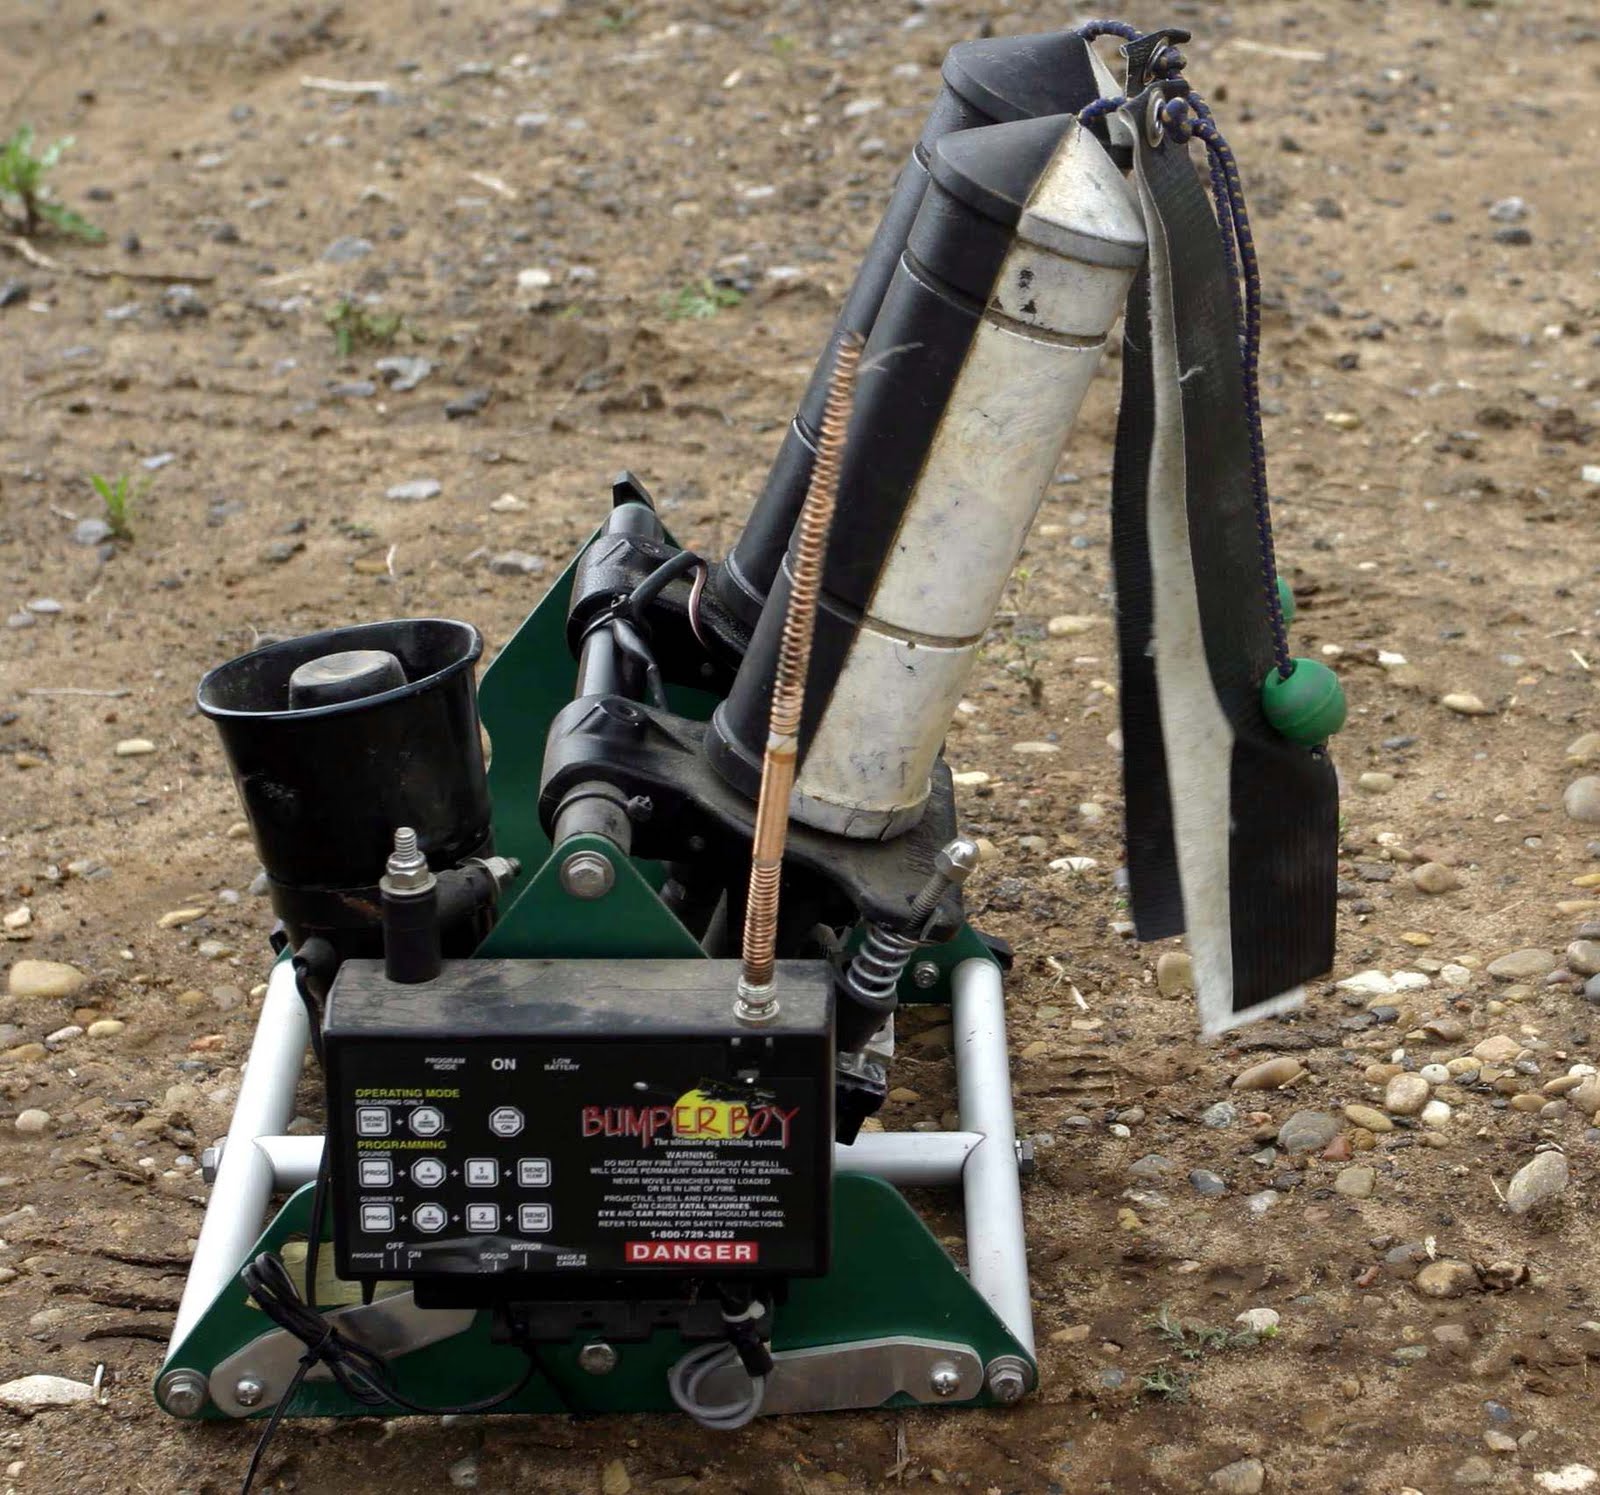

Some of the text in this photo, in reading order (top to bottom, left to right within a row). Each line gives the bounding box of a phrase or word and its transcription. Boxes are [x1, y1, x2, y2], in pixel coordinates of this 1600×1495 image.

[425, 1057, 466, 1065] PROGRAM
[491, 1058, 516, 1071] ON
[355, 1088, 460, 1098] OPERATING MODE
[582, 1105, 799, 1149] BUMPER BOY
[357, 1140, 447, 1150] PROGRAMMING
[654, 1138, 781, 1148] The ultimate dog training system
[665, 1150, 718, 1159] WARNING:
[650, 1231, 735, 1239] 1-800-729-3822
[386, 1242, 404, 1250] OFF
[408, 1251, 421, 1259] ON
[632, 1244, 751, 1260] DANGER
